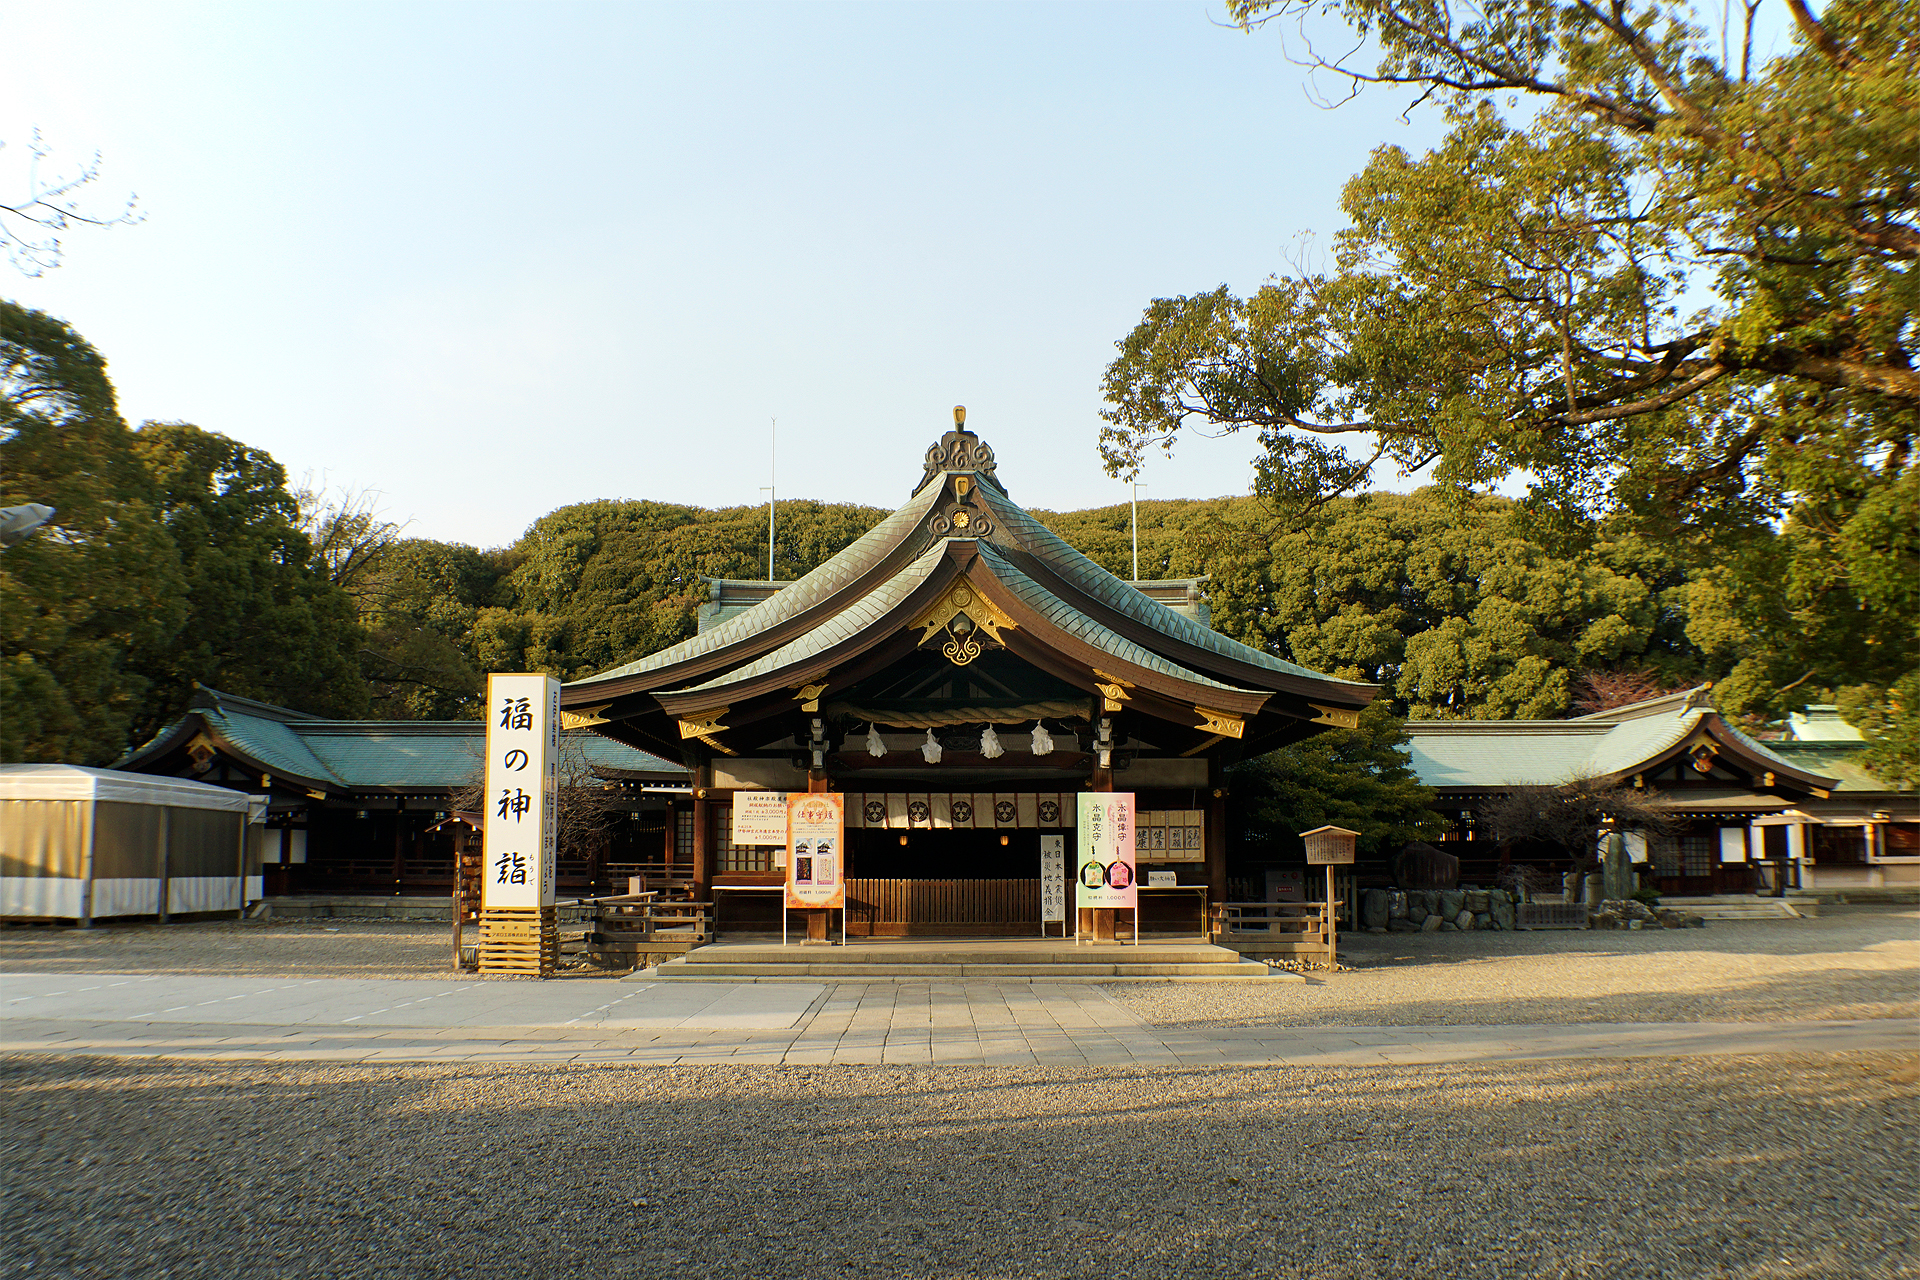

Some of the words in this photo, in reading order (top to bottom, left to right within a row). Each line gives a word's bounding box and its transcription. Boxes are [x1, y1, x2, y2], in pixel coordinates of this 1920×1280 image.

[494, 696, 534, 886] 福の神詣
[1054, 839, 1064, 906] 東日本大震災
